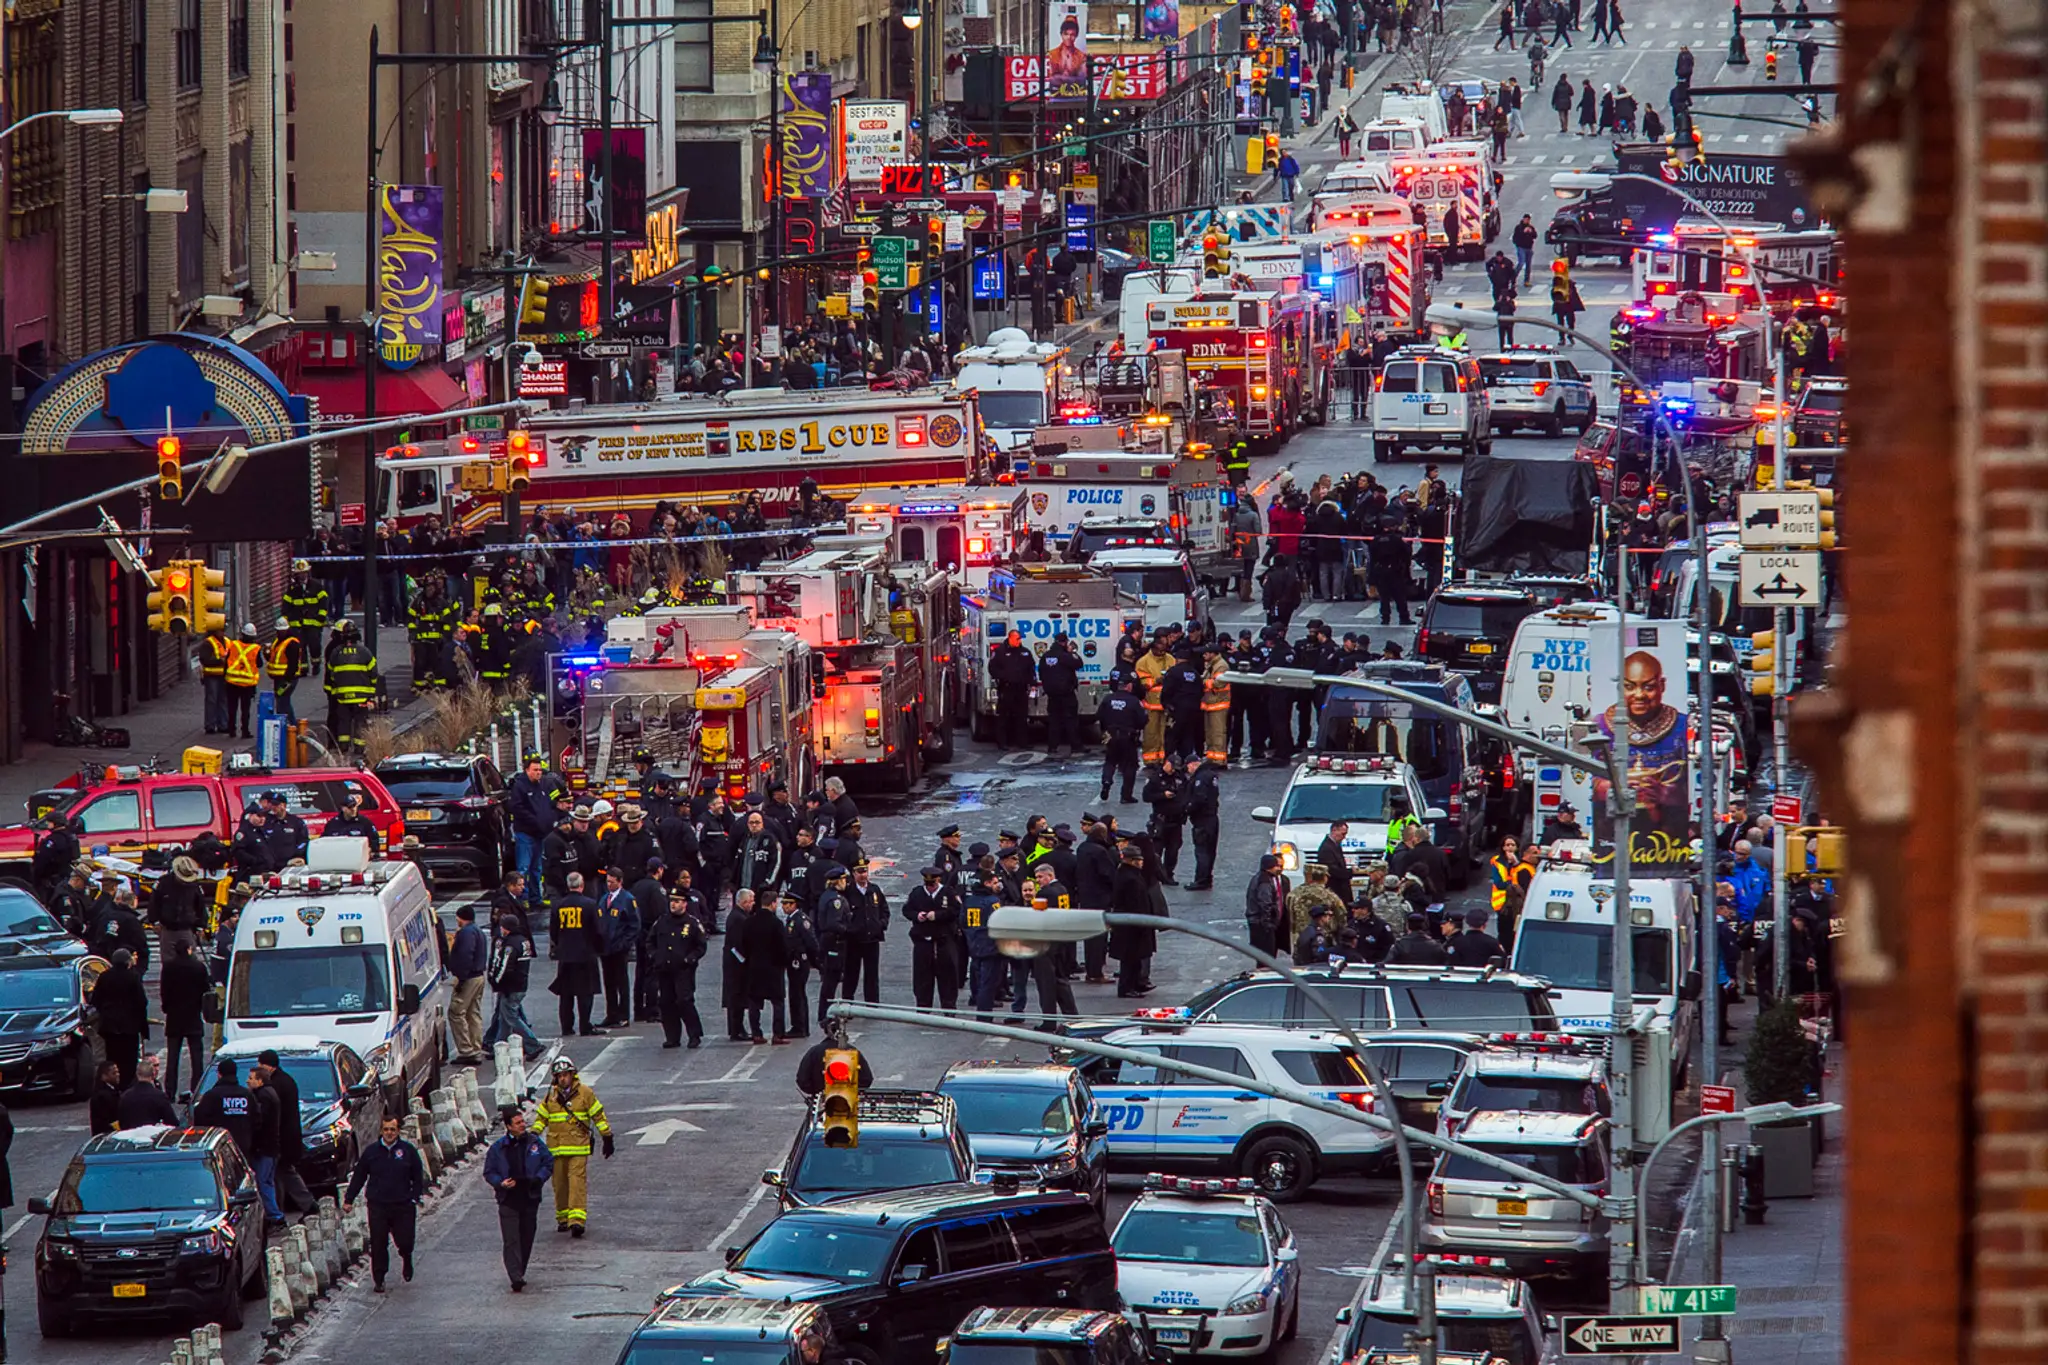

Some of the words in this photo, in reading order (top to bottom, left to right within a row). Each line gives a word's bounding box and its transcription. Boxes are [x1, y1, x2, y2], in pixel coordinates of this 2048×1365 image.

[850, 107, 871, 118] BEST
[873, 106, 896, 117] PRICE
[1680, 164, 1775, 186] SIGNATURE
[1711, 188, 1767, 200] DEMOLITION
[1682, 199, 1755, 214] 718932.2222
[382, 184, 438, 344] Aladdin
[873, 256, 904, 264] Hudson
[1262, 262, 1296, 274] FDNY
[1174, 306, 1210, 318] SQUAD
[642, 334, 664, 345] Club
[520, 363, 564, 371] MNEY
[521, 373, 564, 381] CHANGE
[598, 436, 625, 448] FIRE
[628, 432, 704, 446] DEPARTMENT
[598, 450, 624, 461] CITY
[627, 449, 642, 460] OF
[646, 448, 670, 459] NEW
[673, 446, 706, 458] YORK
[1620, 478, 1641, 491] STOP
[1067, 489, 1123, 504] POLICE
[1183, 488, 1216, 501] POLICE
[1783, 504, 1815, 515] TRUCK
[1783, 523, 1815, 533] ROUTE
[1443, 543, 1453, 585] NYPD
[1589, 551, 1598, 579] NYP
[1760, 558, 1800, 568] LOCAL
[1016, 618, 1110, 639] POLICE
[1544, 640, 1587, 654] NYP
[1532, 653, 1590, 672] POLI
[1550, 889, 1574, 898] NYPD
[259, 916, 285, 925] NYPD
[338, 913, 363, 921] NYPD
[559, 907, 582, 929] FBI
[222, 1097, 248, 1108] NYPD
[1102, 1105, 1145, 1131] YPD
[120, 1249, 135, 1257] Ford
[1152, 1296, 1200, 1306] POLICE
[1660, 1290, 1677, 1311] W
[1582, 1328, 1615, 1343] ONE
[1630, 1327, 1665, 1342] WAY
